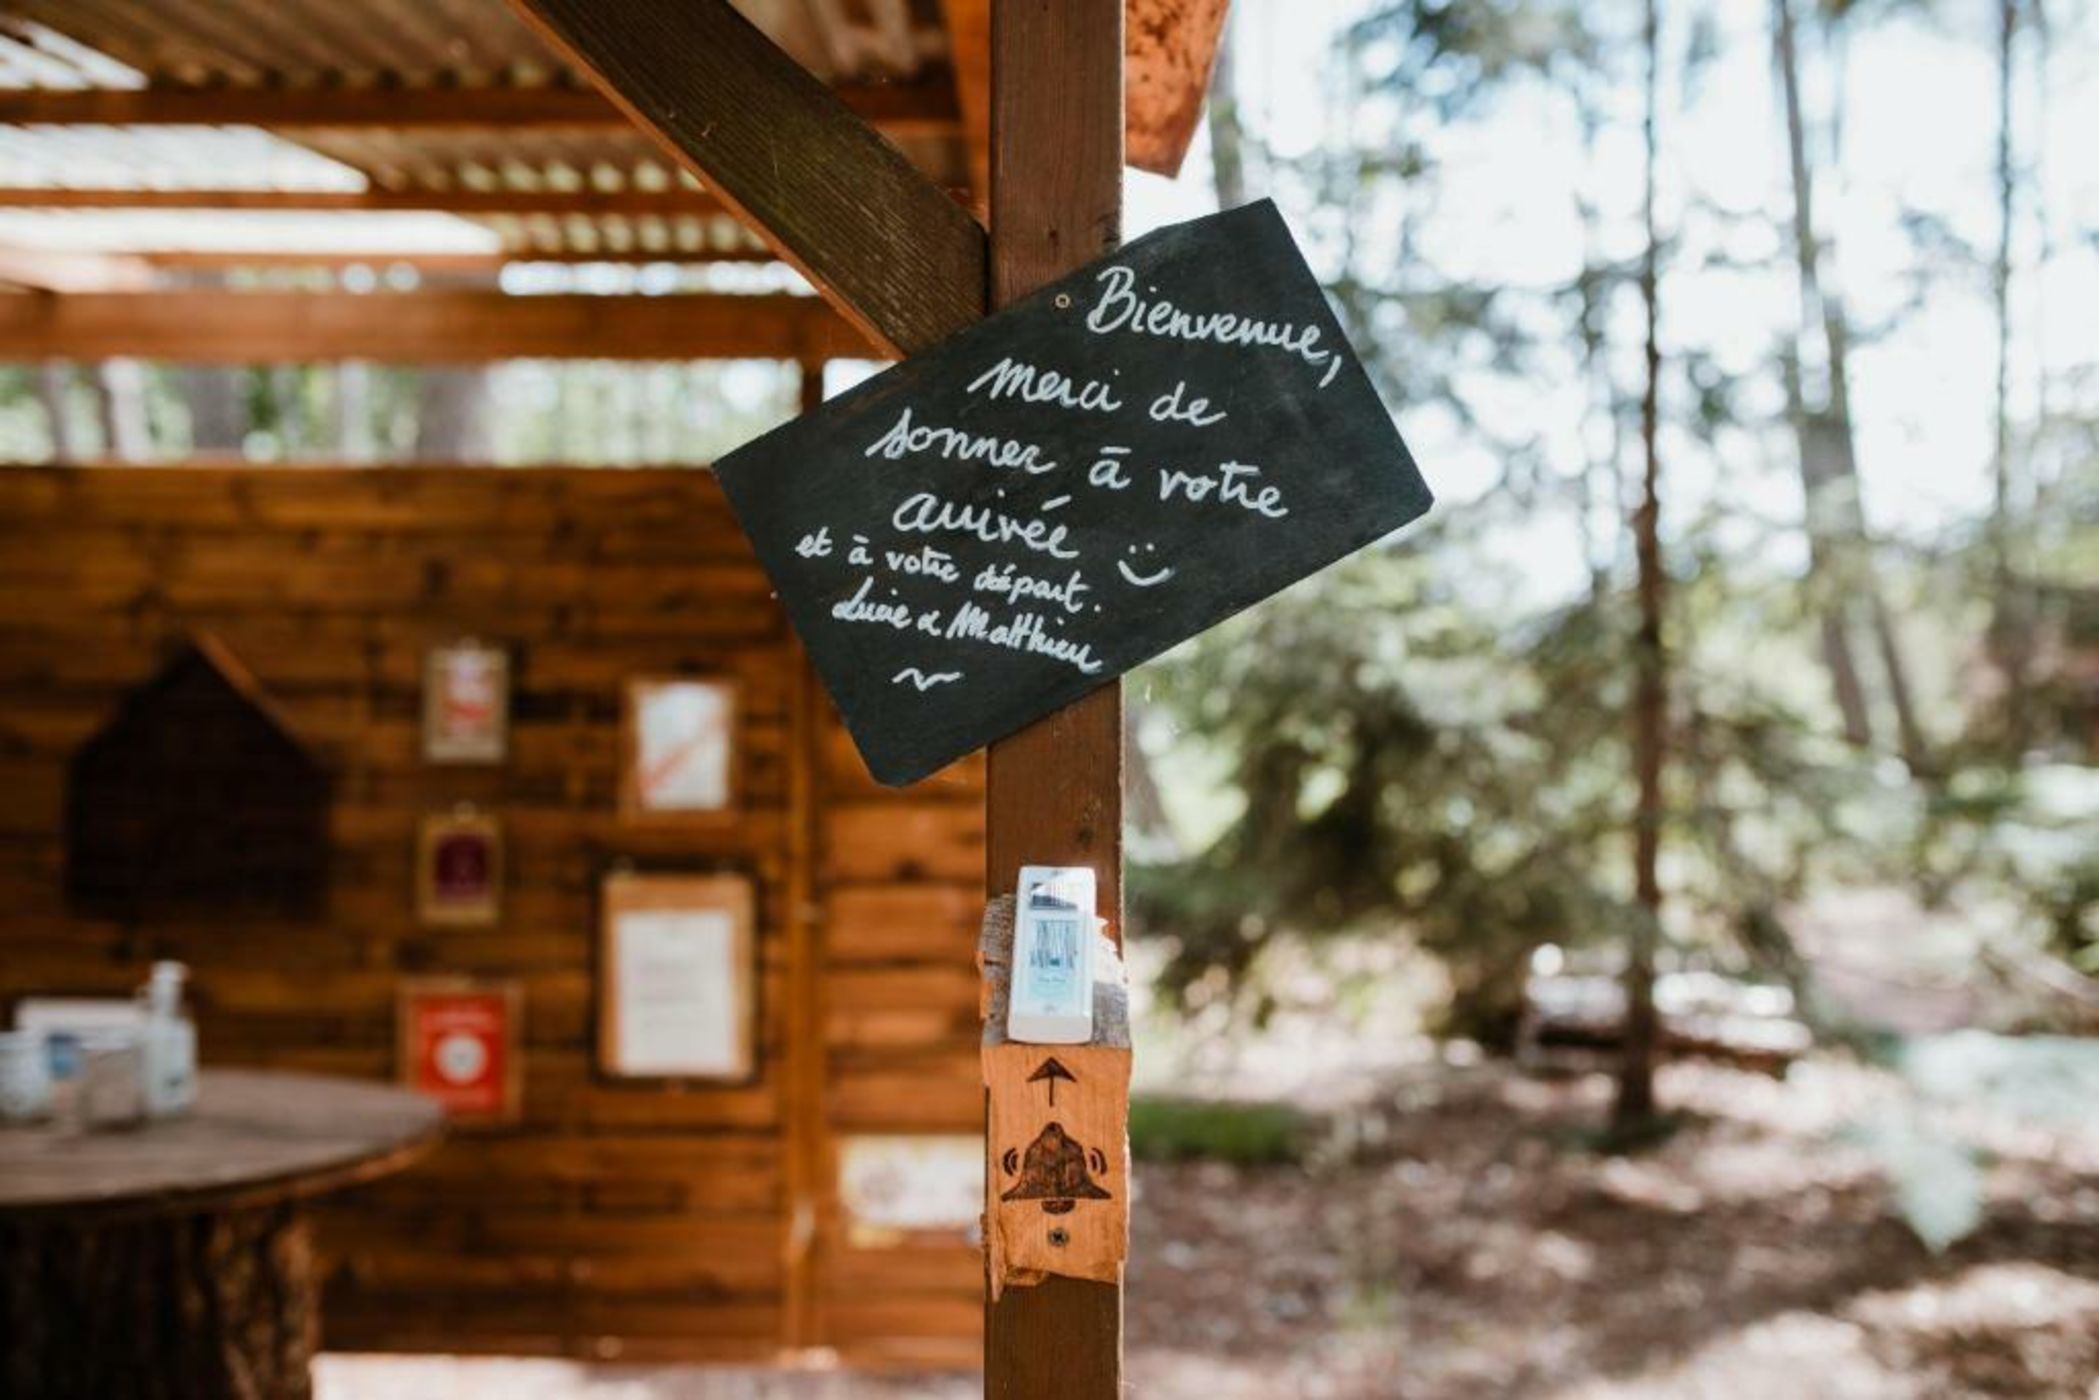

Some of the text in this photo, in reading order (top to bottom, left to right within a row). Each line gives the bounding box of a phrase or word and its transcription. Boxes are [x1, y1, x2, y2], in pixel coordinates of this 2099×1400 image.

[1086, 265, 1342, 389] Bienvenue,
[1148, 380, 1227, 427] de
[864, 407, 1057, 475] sonner
[1159, 460, 1289, 518] votre
[795, 526, 833, 559] et
[885, 545, 960, 583] votre
[892, 488, 1080, 560] arrivée
[945, 601, 1104, 673] Matthieu
